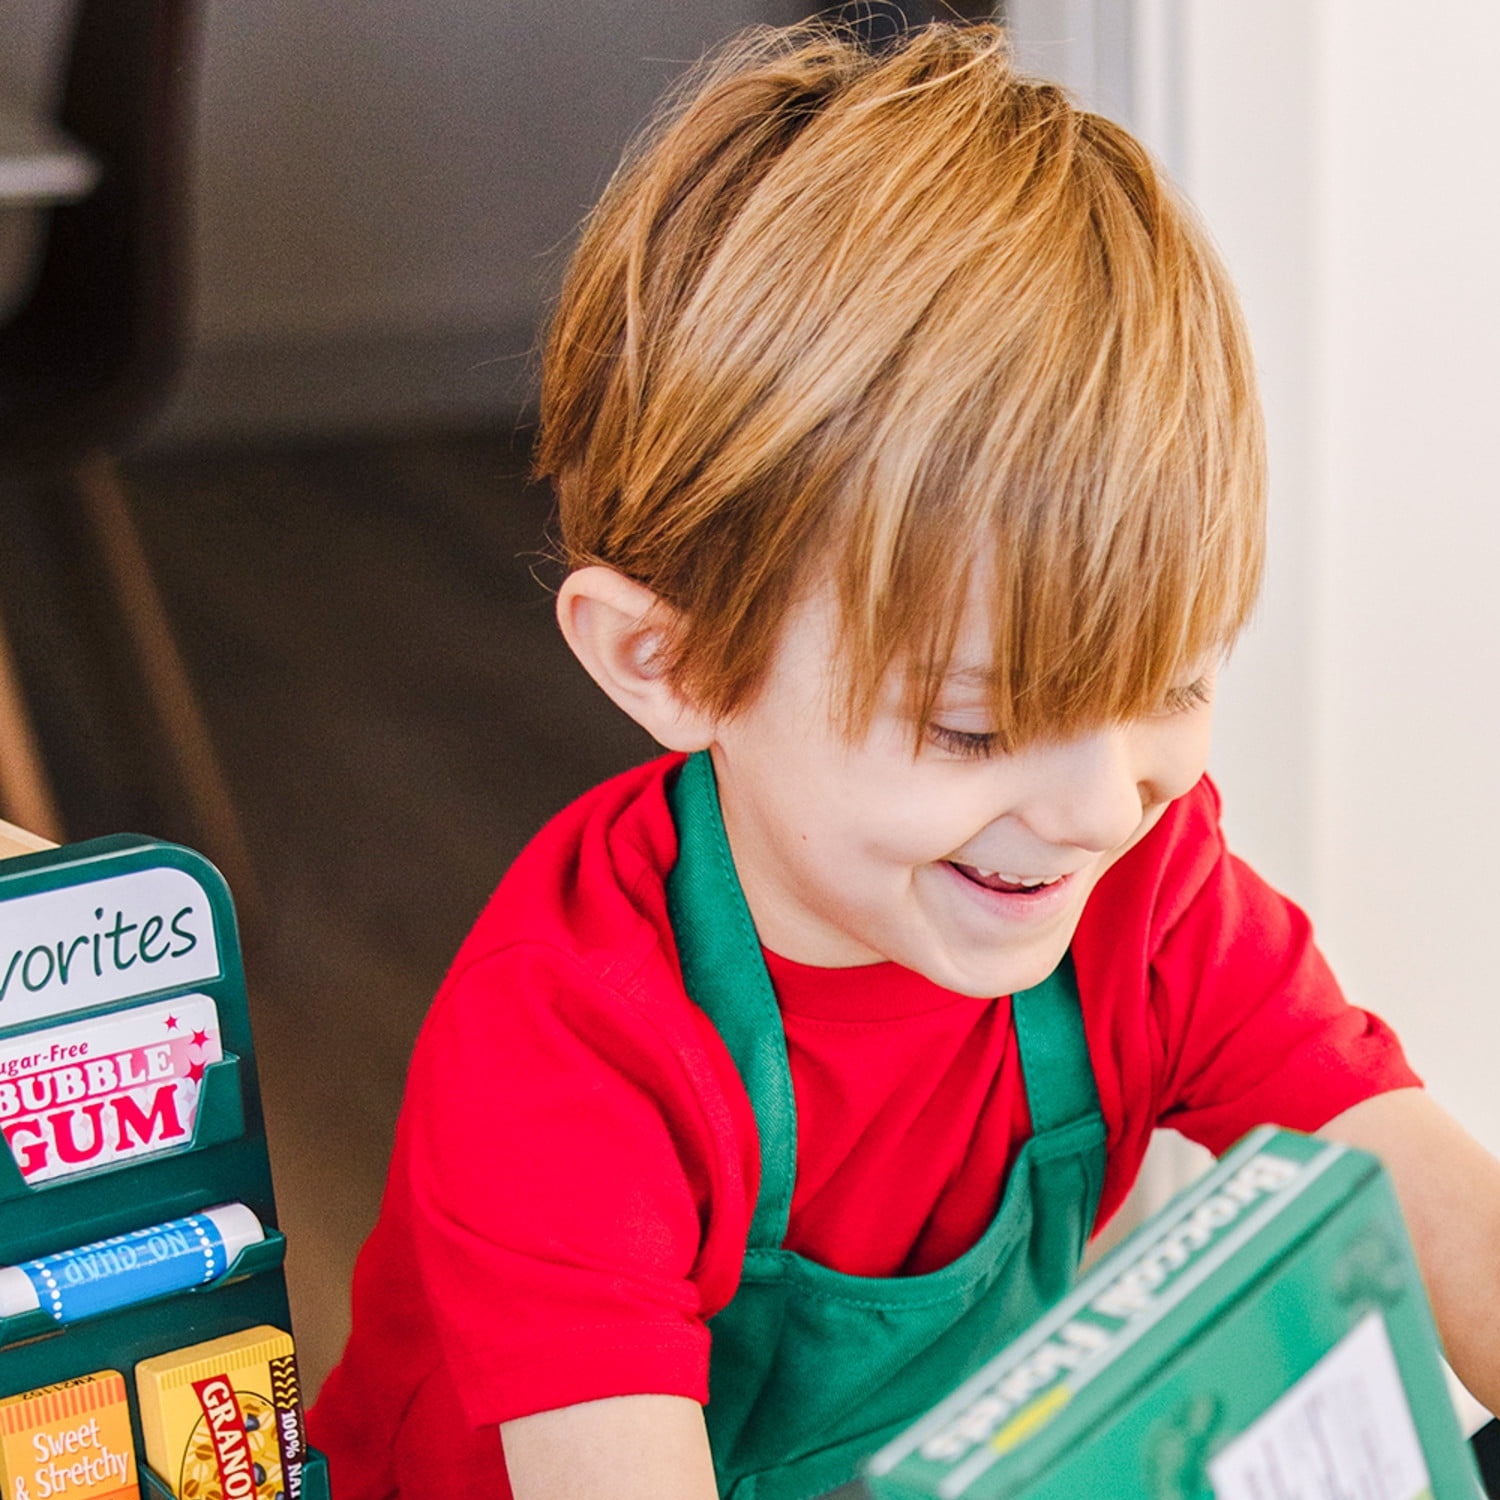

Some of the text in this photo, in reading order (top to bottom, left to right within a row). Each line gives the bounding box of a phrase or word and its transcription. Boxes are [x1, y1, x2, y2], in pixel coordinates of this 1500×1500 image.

[0, 1042, 88, 1076] ugar-Free
[0, 1043, 175, 1118] BUBBLE
[2, 1084, 185, 1176] GUM
[64, 1230, 190, 1283] NO-CHAP
[32, 1418, 102, 1463] Sweet
[281, 1409, 300, 1458] 100%
[35, 1447, 128, 1499] Stretchy
